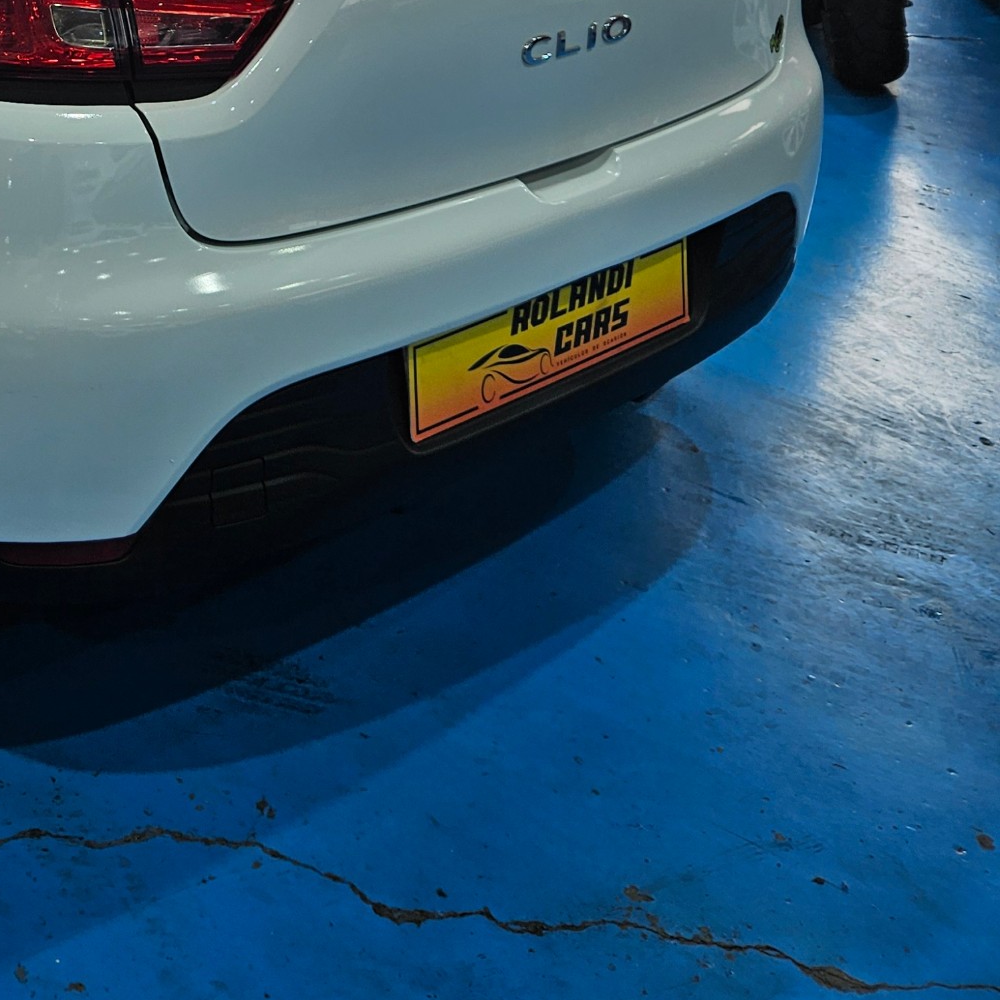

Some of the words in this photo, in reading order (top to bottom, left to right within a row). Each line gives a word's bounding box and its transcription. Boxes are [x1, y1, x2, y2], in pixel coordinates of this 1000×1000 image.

[521, 14, 632, 67] CLIO
[510, 259, 635, 336] ROLANDI
[554, 297, 630, 357] CARS
